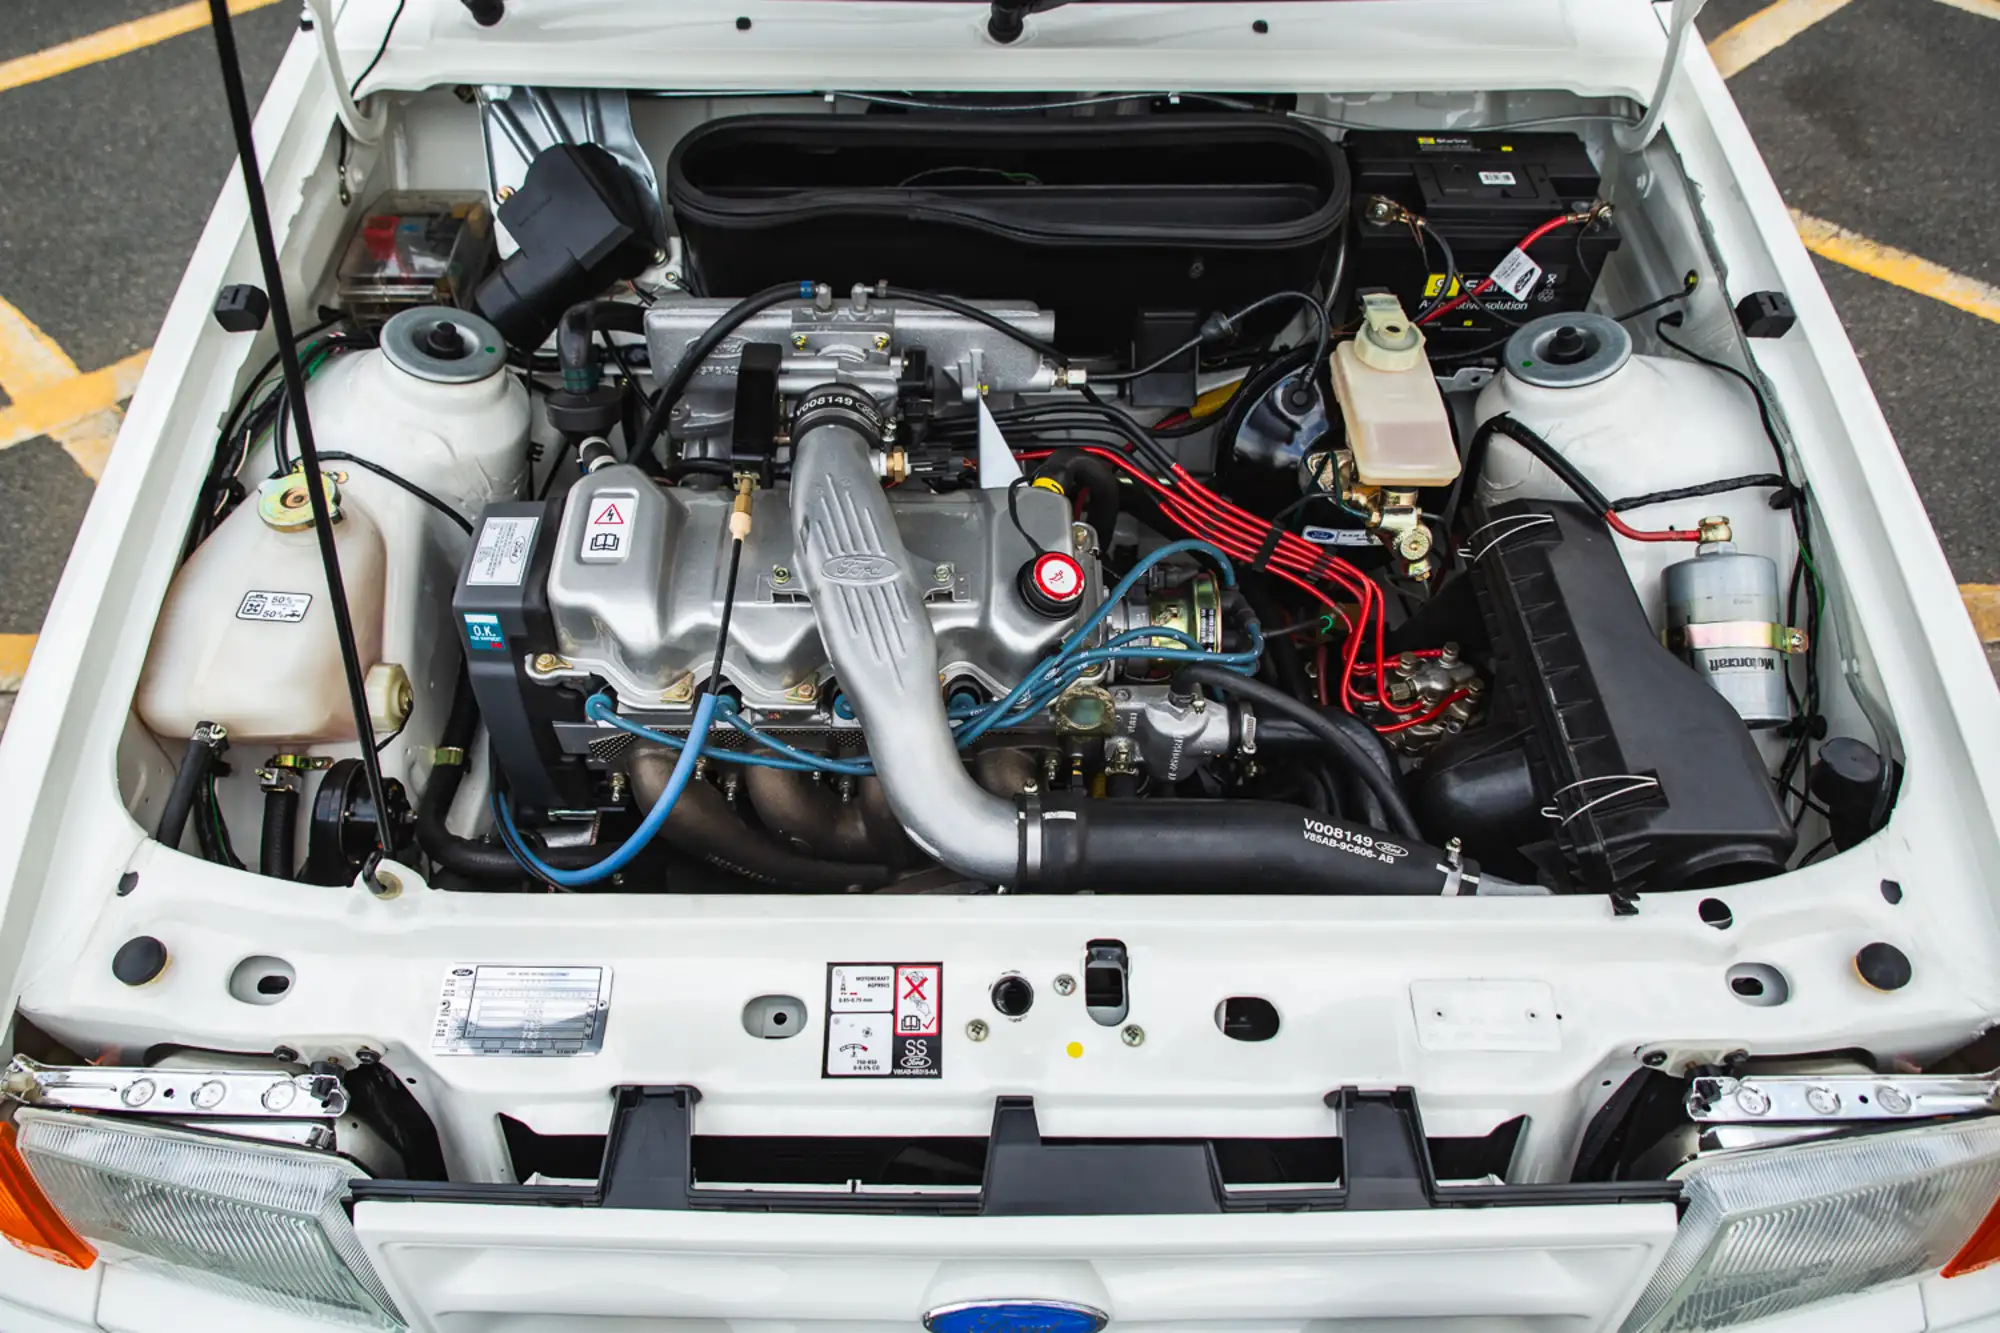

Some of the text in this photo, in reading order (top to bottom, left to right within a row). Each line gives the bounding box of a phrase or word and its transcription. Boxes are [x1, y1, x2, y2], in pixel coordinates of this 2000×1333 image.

[1485, 300, 1528, 310] solution
[796, 395, 853, 417] V008149
[833, 557, 886, 579] Ford
[473, 625, 497, 637] O.K.
[1709, 656, 1775, 672] Motorcraft
[1303, 817, 1373, 847] V008149
[1378, 853, 1394, 864] AB
[905, 1039, 928, 1057] SS
